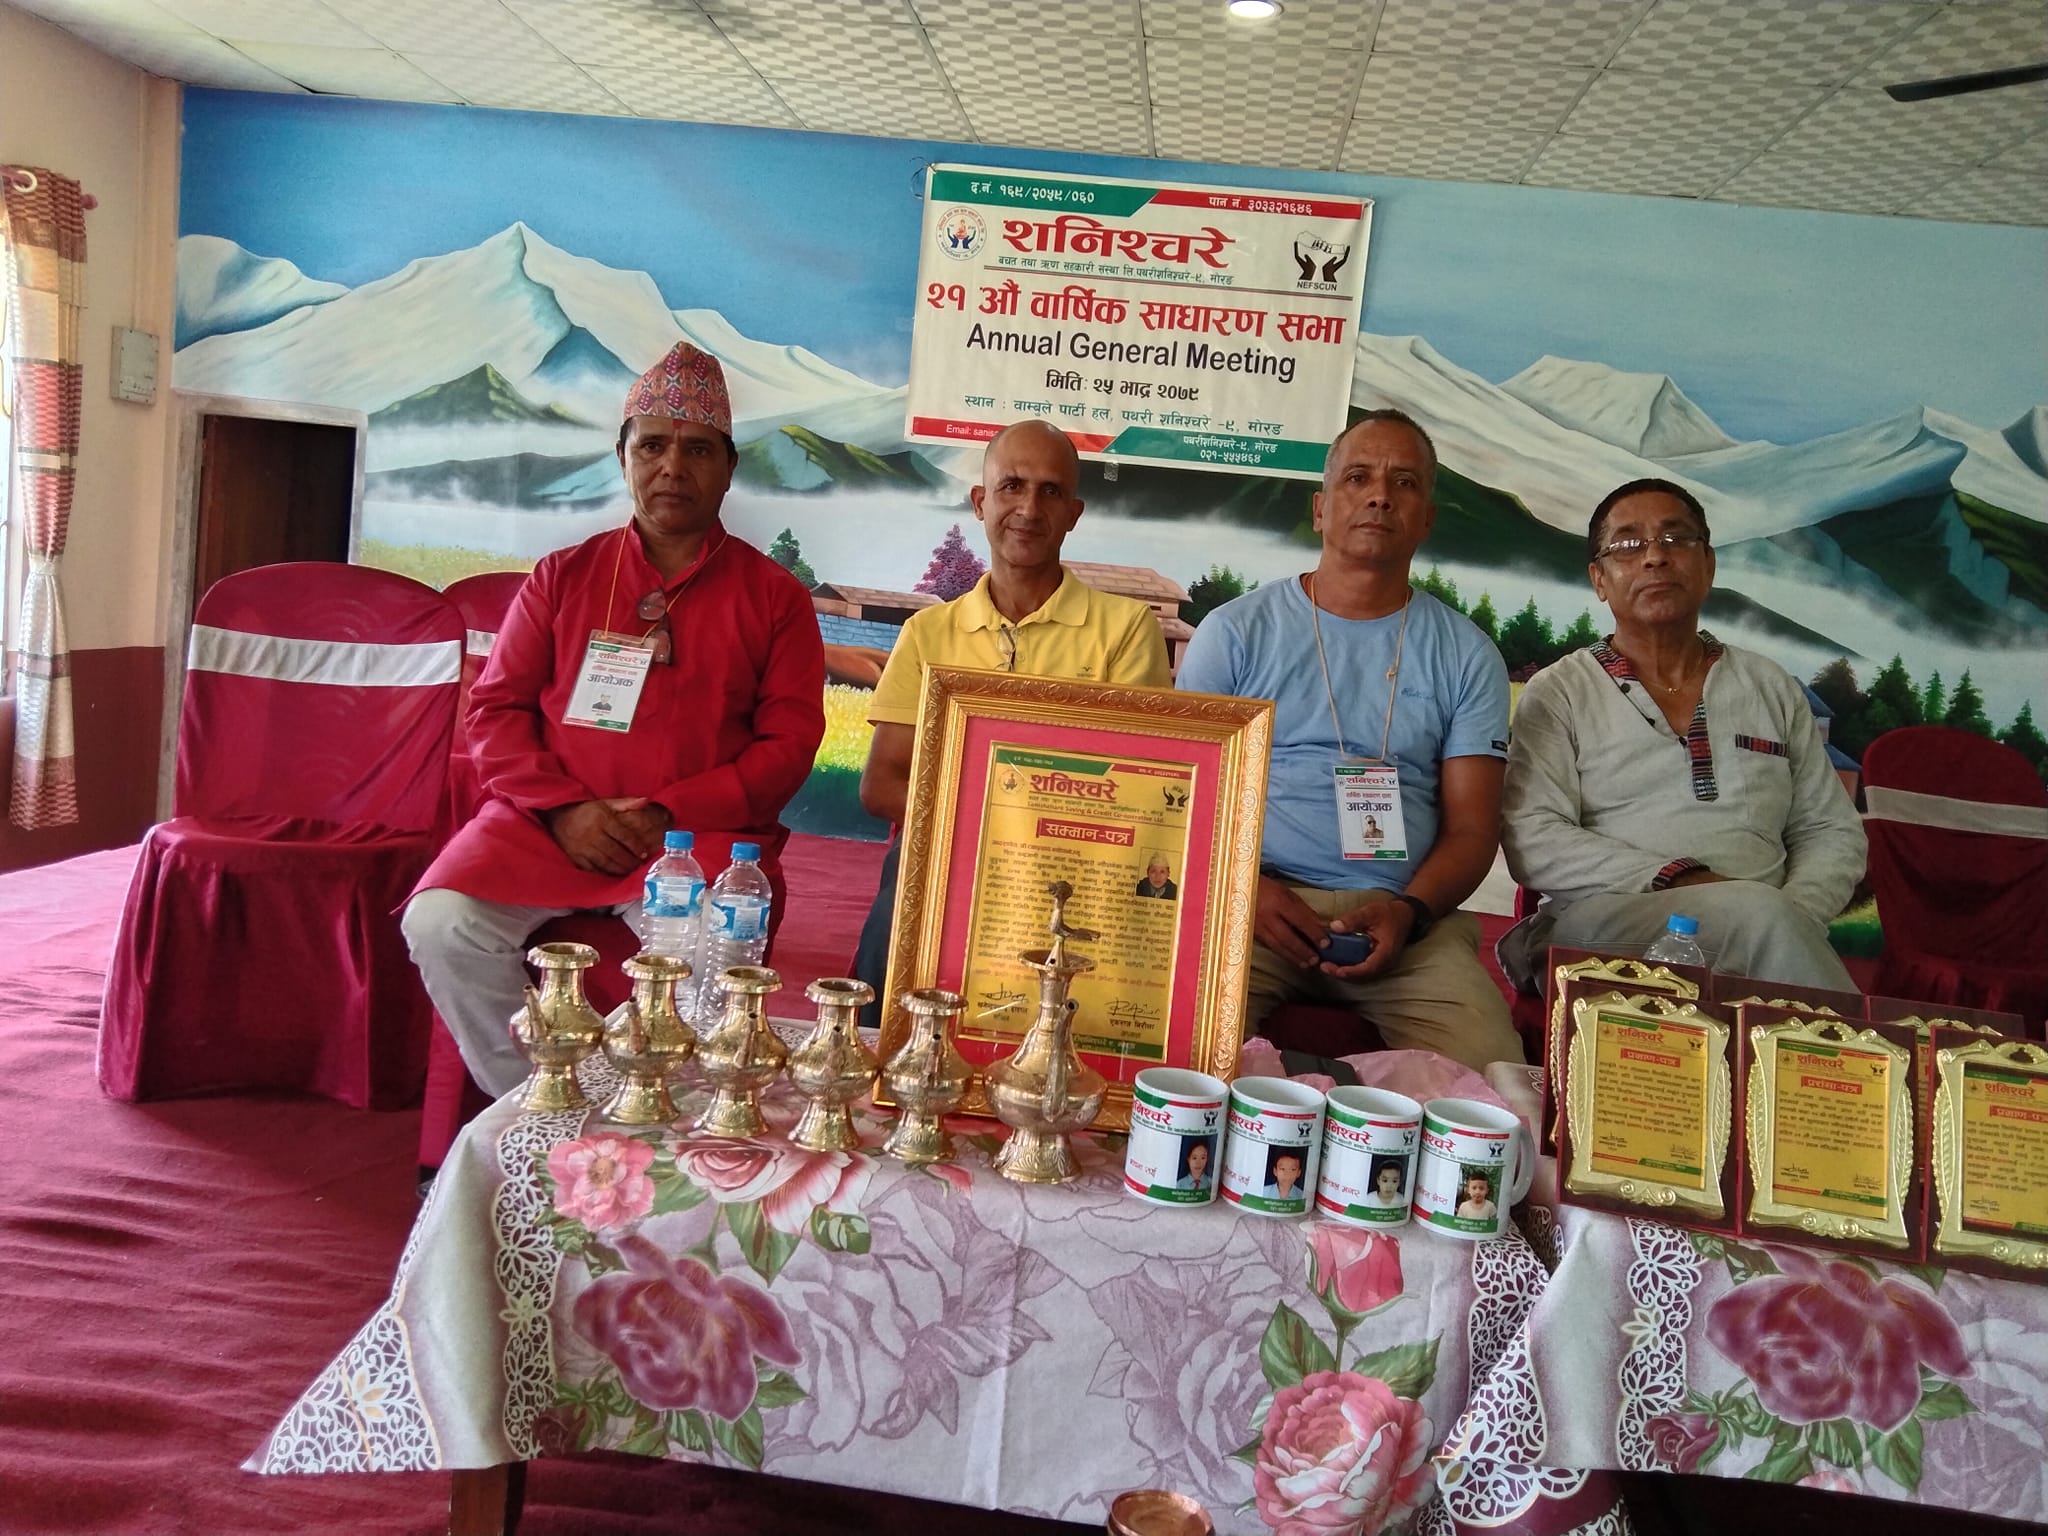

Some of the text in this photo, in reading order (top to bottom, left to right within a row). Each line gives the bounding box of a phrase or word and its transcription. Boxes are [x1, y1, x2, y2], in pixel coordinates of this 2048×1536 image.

[1248, 199, 1313, 215] ३०३३२१६४६
[1002, 215, 1236, 268] शनिश्चरे
[998, 256, 1017, 266] बचत
[1063, 260, 1094, 274] सहकारी
[1297, 281, 1338, 292] NEFSCUN
[927, 282, 966, 311] २१
[1030, 285, 1130, 325] वार्षिक
[1139, 300, 1268, 337] साधारण
[1277, 312, 1347, 344] सभा
[966, 322, 1296, 384] Annual General Meeting
[1093, 380, 1114, 395] २५
[1120, 379, 1152, 399] भाद्र
[1158, 384, 1199, 401] २०७९
[1121, 405, 1154, 423] पथरी
[1160, 409, 1211, 430] शनिश्चरे
[946, 423, 972, 435] Email:
[1030, 772, 1120, 801] शनिश्चरे
[1093, 809, 1113, 817] Credit
[1345, 799, 1393, 812] आयोजक
